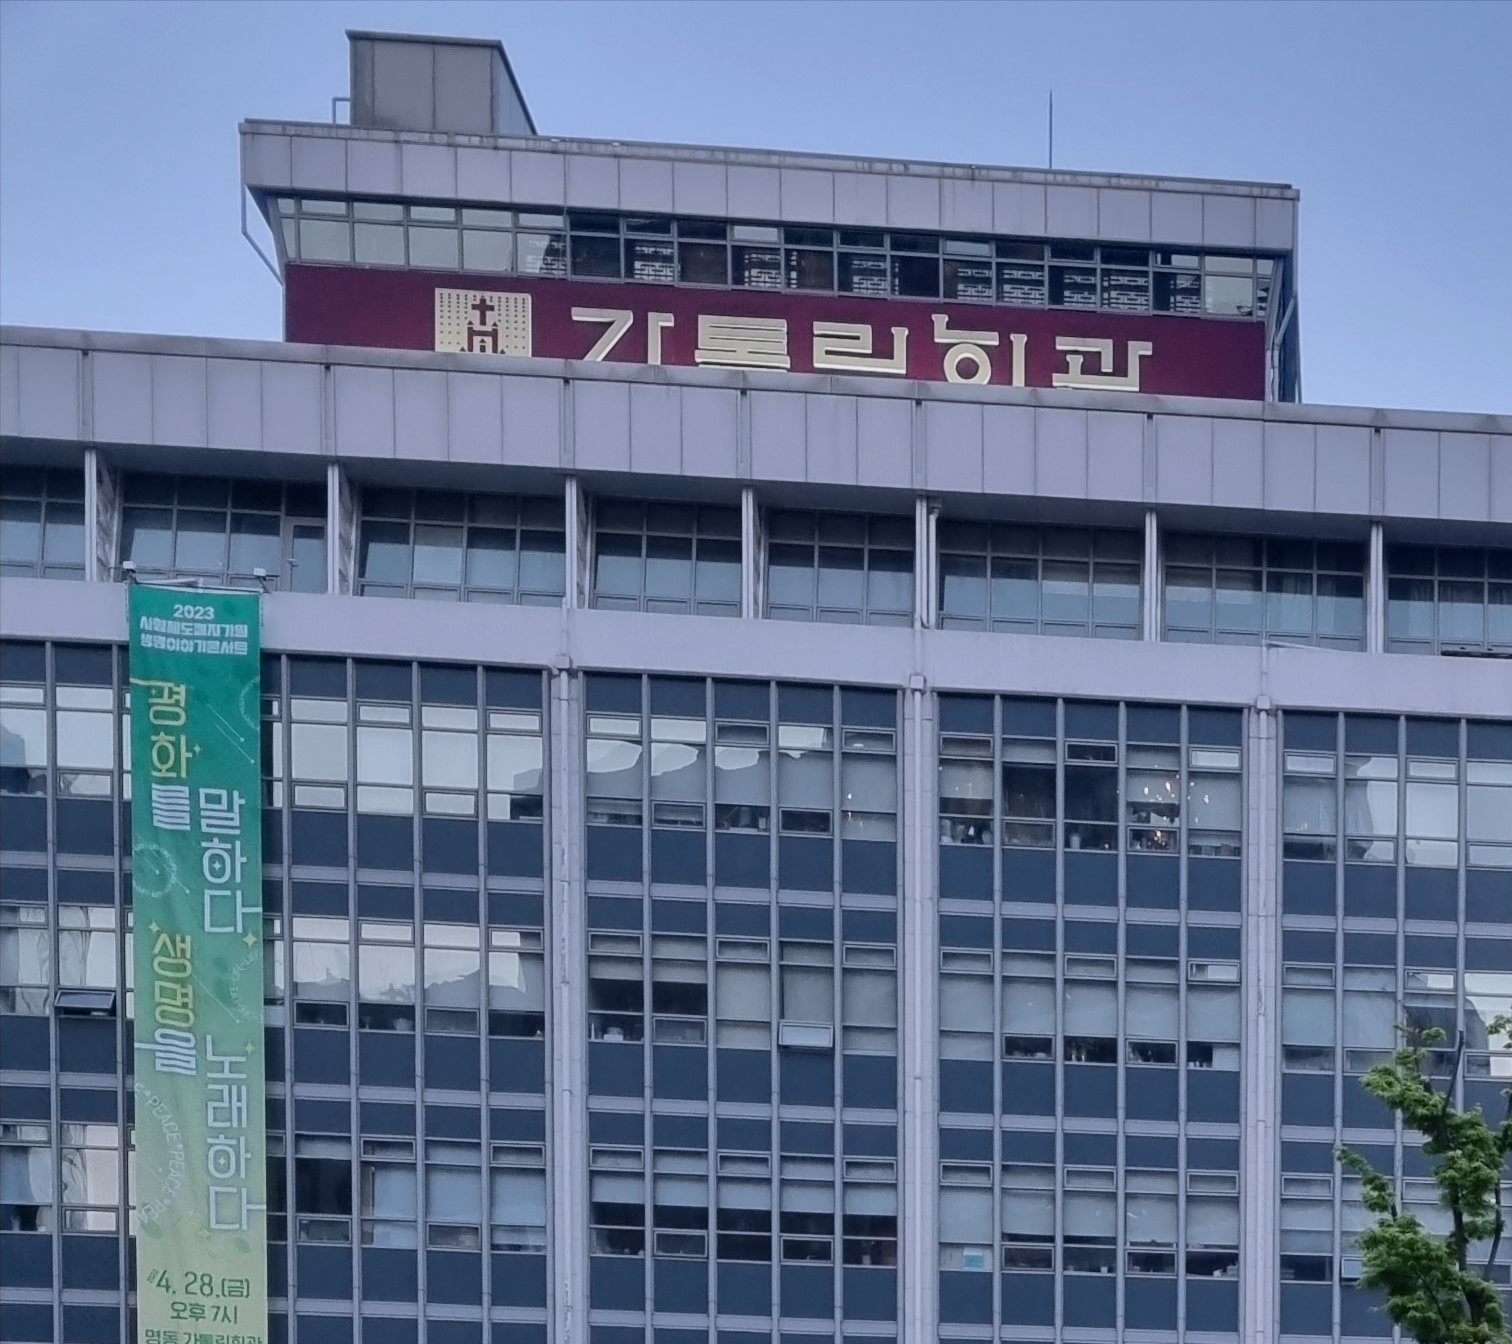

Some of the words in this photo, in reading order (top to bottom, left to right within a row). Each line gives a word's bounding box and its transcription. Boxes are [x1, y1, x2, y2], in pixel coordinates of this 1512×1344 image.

[173, 604, 215, 620] 2023
[130, 677, 191, 831] 평화를
[199, 787, 263, 934] 말하다
[134, 933, 197, 1076] 생명을
[206, 1034, 266, 1231] 노래하다
[170, 1301, 206, 1322] 오후
[211, 1304, 238, 1324] 7시
